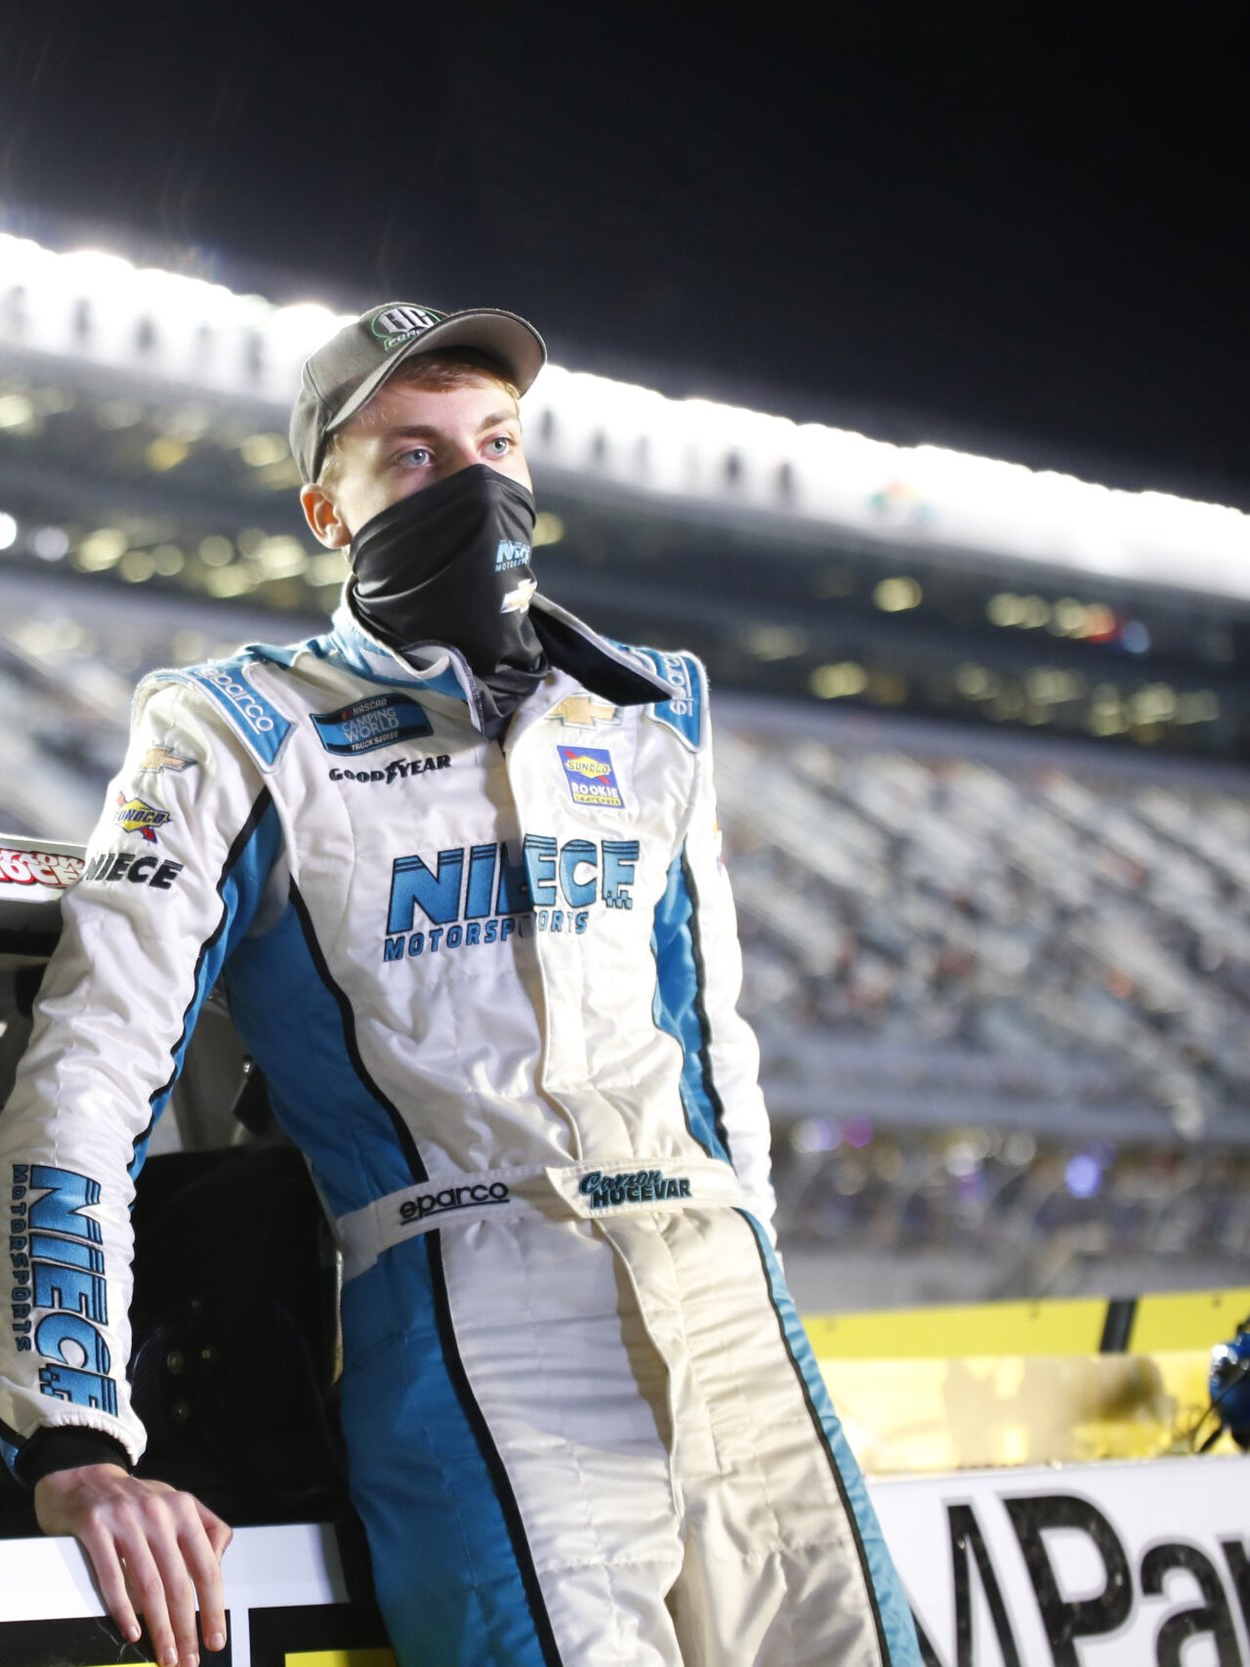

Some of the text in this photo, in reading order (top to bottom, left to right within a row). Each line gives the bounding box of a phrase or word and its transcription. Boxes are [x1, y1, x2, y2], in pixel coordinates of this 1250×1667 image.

[342, 707, 396, 732] CAMPING
[352, 699, 387, 716] NASCAR
[344, 717, 398, 743] WORLD
[568, 761, 609, 774] SUNOCO
[571, 782, 619, 798] ROOKIE
[114, 808, 166, 824] UNOCO
[85, 852, 184, 890] NIECE
[386, 833, 640, 935] NIECE
[590, 1178, 693, 1210] HOCEVAR
[9, 1163, 32, 1352] MOTORSPORTS
[28, 1164, 119, 1418] NIECE
